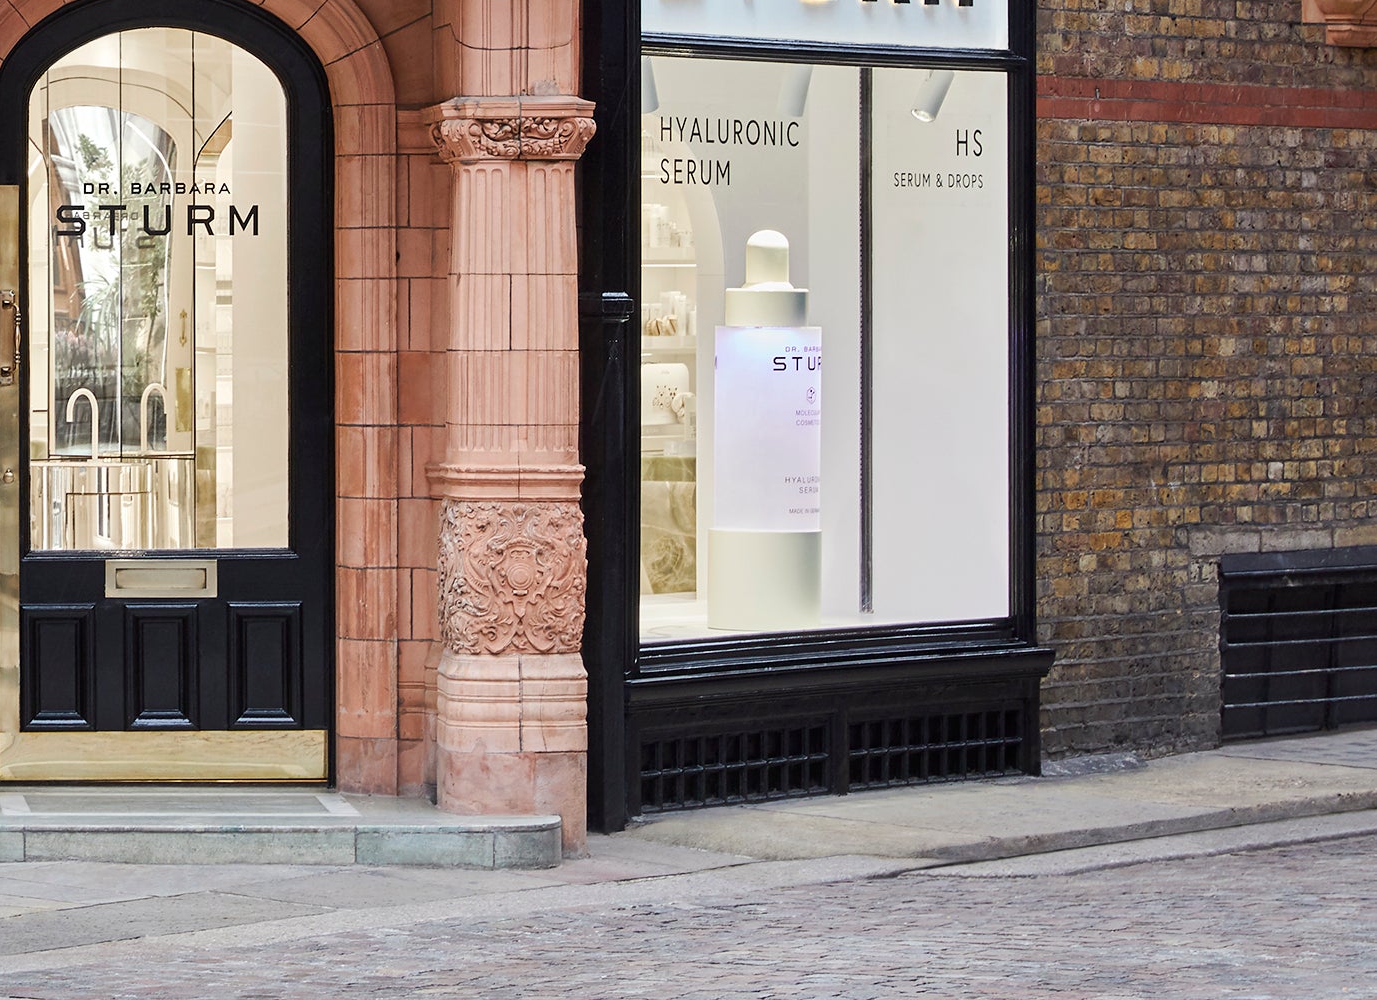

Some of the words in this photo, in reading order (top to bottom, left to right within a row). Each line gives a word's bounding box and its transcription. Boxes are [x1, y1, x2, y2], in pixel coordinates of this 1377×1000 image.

[660, 116, 800, 147] HYALURONIC
[956, 128, 983, 157] HS
[660, 158, 731, 185] SERUM
[893, 172, 931, 188] SERUM
[935, 173, 944, 188] &
[947, 173, 984, 189] DROPS
[83, 182, 118, 195] DR.
[130, 182, 231, 195] BARBARA
[56, 204, 259, 236] STURM
